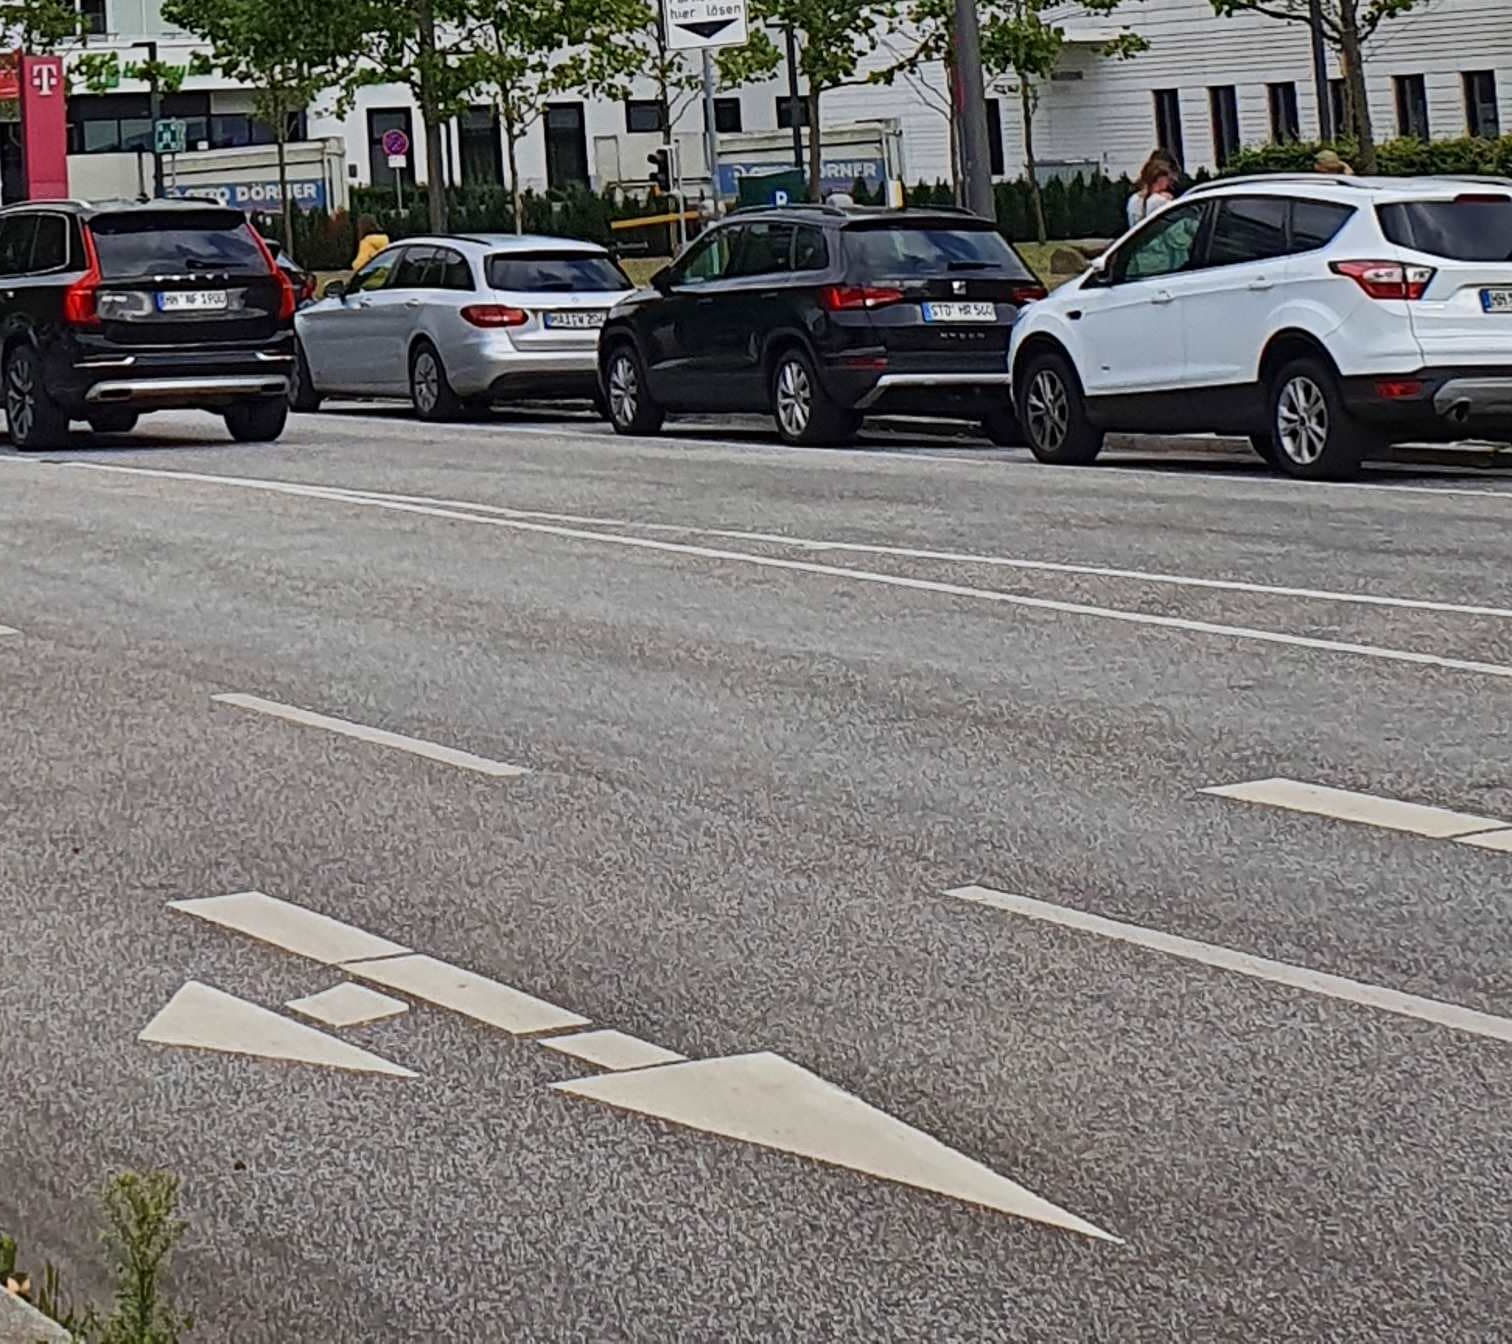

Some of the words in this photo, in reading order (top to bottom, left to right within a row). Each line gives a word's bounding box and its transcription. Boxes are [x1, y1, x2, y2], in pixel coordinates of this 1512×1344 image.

[670, 8, 695, 20] hier
[706, 4, 741, 16] lösen
[32, 63, 57, 95] T
